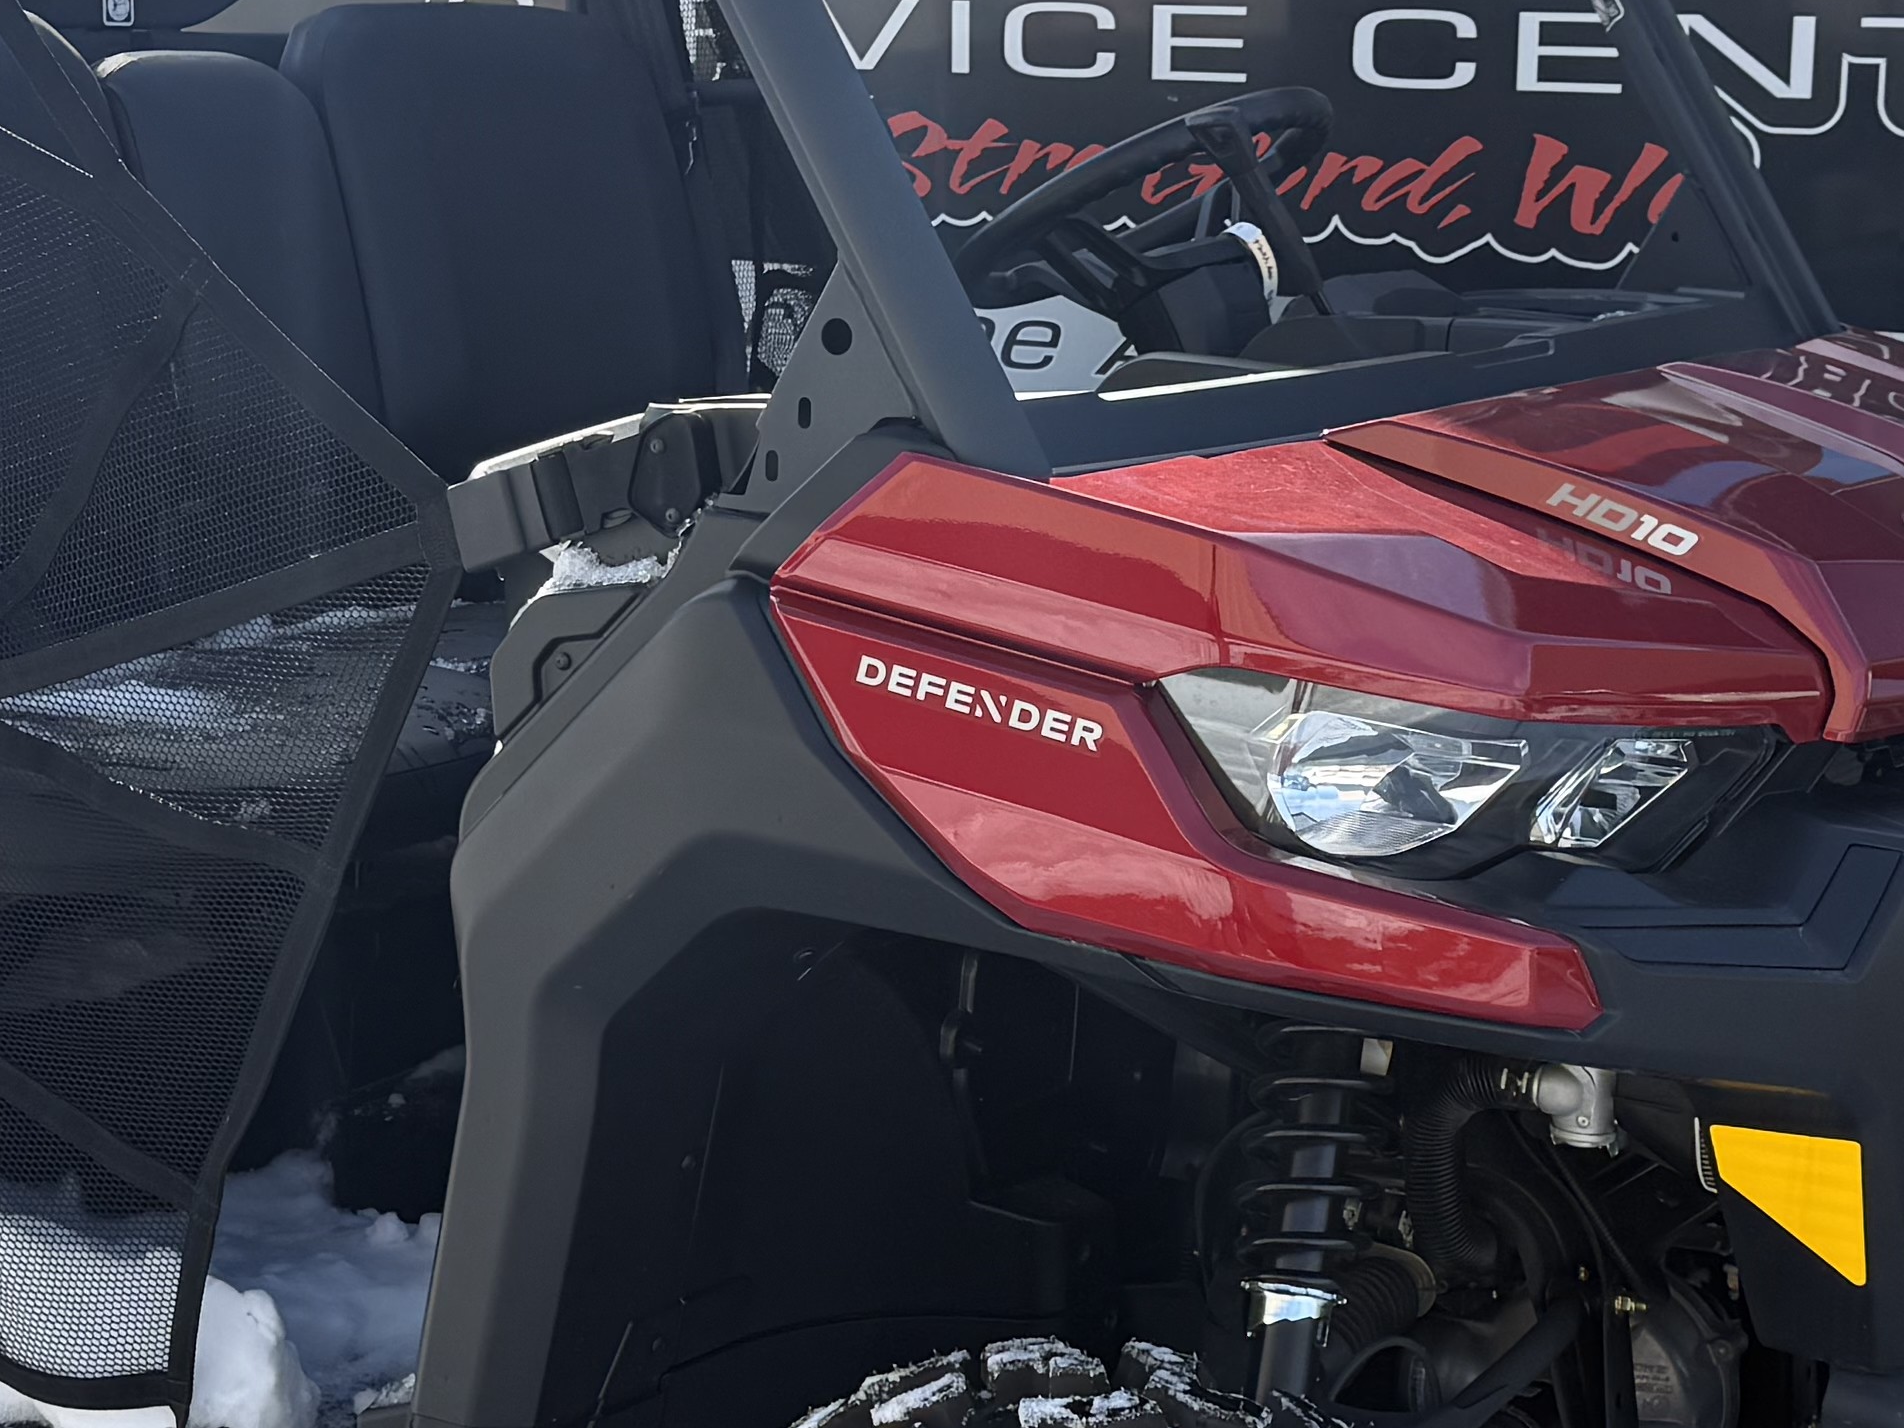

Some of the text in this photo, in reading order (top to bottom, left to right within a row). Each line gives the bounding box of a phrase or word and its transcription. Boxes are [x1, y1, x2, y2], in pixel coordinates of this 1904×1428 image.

[888, 110, 1484, 229] Strrd,
[1546, 482, 1700, 556] HD10
[855, 654, 1103, 752] DEFENDER
